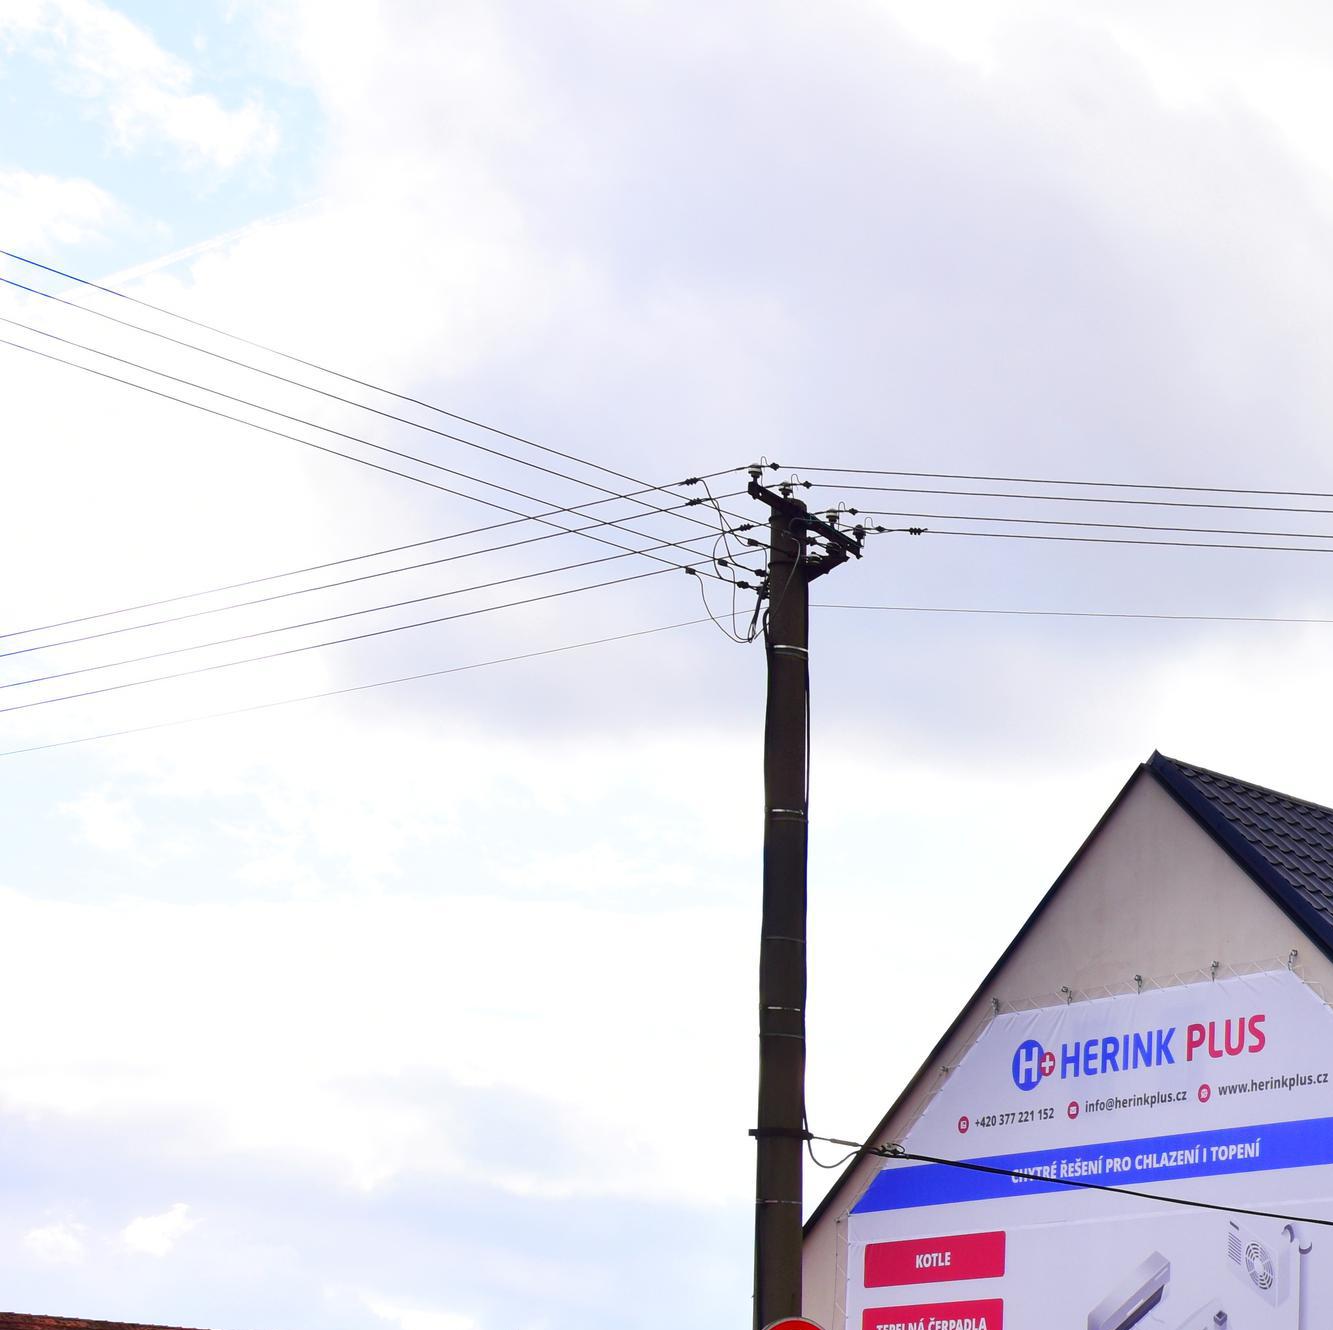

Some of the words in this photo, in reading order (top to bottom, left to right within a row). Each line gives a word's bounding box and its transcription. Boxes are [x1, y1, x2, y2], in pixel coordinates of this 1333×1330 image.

[1061, 1027, 1176, 1080] HERINK
[1186, 1014, 1266, 1062] PLUS
[1218, 1072, 1329, 1097] www.herinkplus.cz
[1085, 1089, 1187, 1113] info@herinkplus.cz
[974, 1114, 997, 1129] +420
[999, 1112, 1015, 1126] 377
[1018, 1110, 1036, 1124] 221
[1038, 1107, 1055, 1121] 152
[1011, 1161, 1057, 1184] CHYTRÉ
[1060, 1155, 1103, 1179] ŘEŠENÍ
[1106, 1156, 1132, 1173] PRO
[1135, 1145, 1200, 1171] CHLAZENÍ
[1203, 1148, 1207, 1163] I
[1210, 1138, 1262, 1162] TOPENÍ
[915, 1252, 951, 1269] KOTLE
